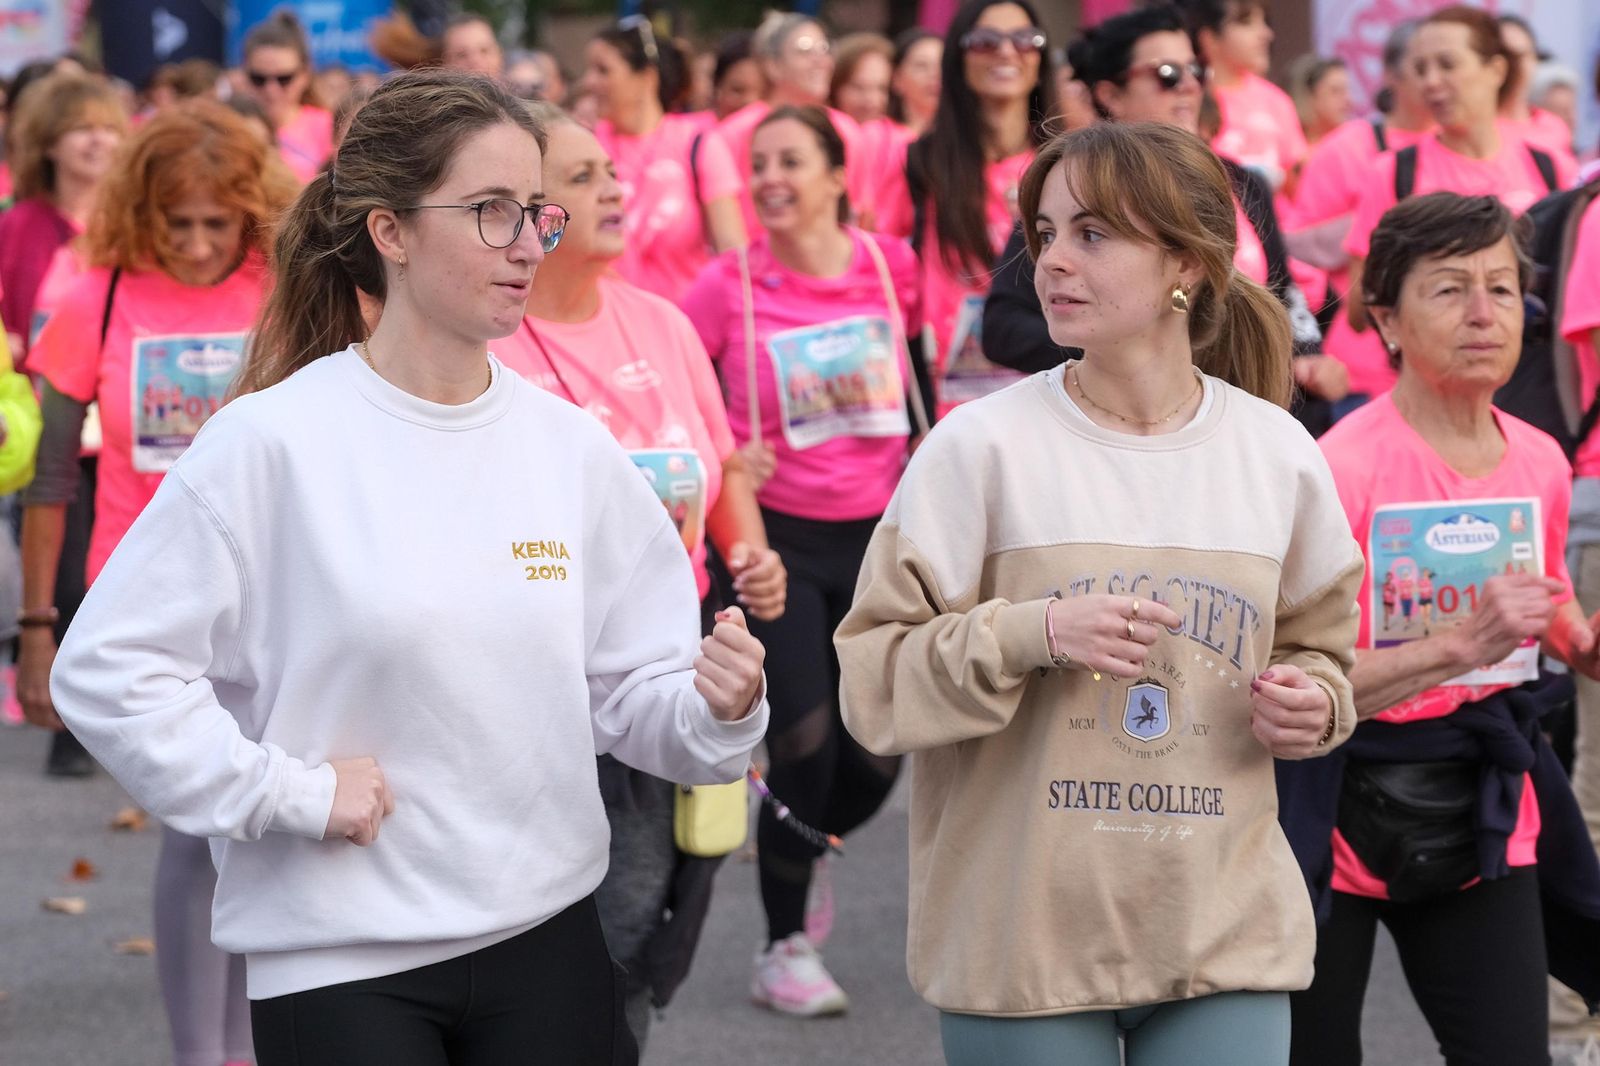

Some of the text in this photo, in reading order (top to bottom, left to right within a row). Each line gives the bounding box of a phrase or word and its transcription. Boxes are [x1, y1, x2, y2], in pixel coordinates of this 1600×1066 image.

[511, 540, 571, 560] KENIA
[525, 564, 567, 581] 2019
[1159, 661, 1187, 689] AREA
[1068, 717, 1096, 731] MCM
[1191, 722, 1211, 737] XCV
[1111, 736, 1181, 759] ONLY THE BRAVE
[1048, 779, 1225, 817] STATE COLLEGE
[1093, 818, 1194, 842] University of life
